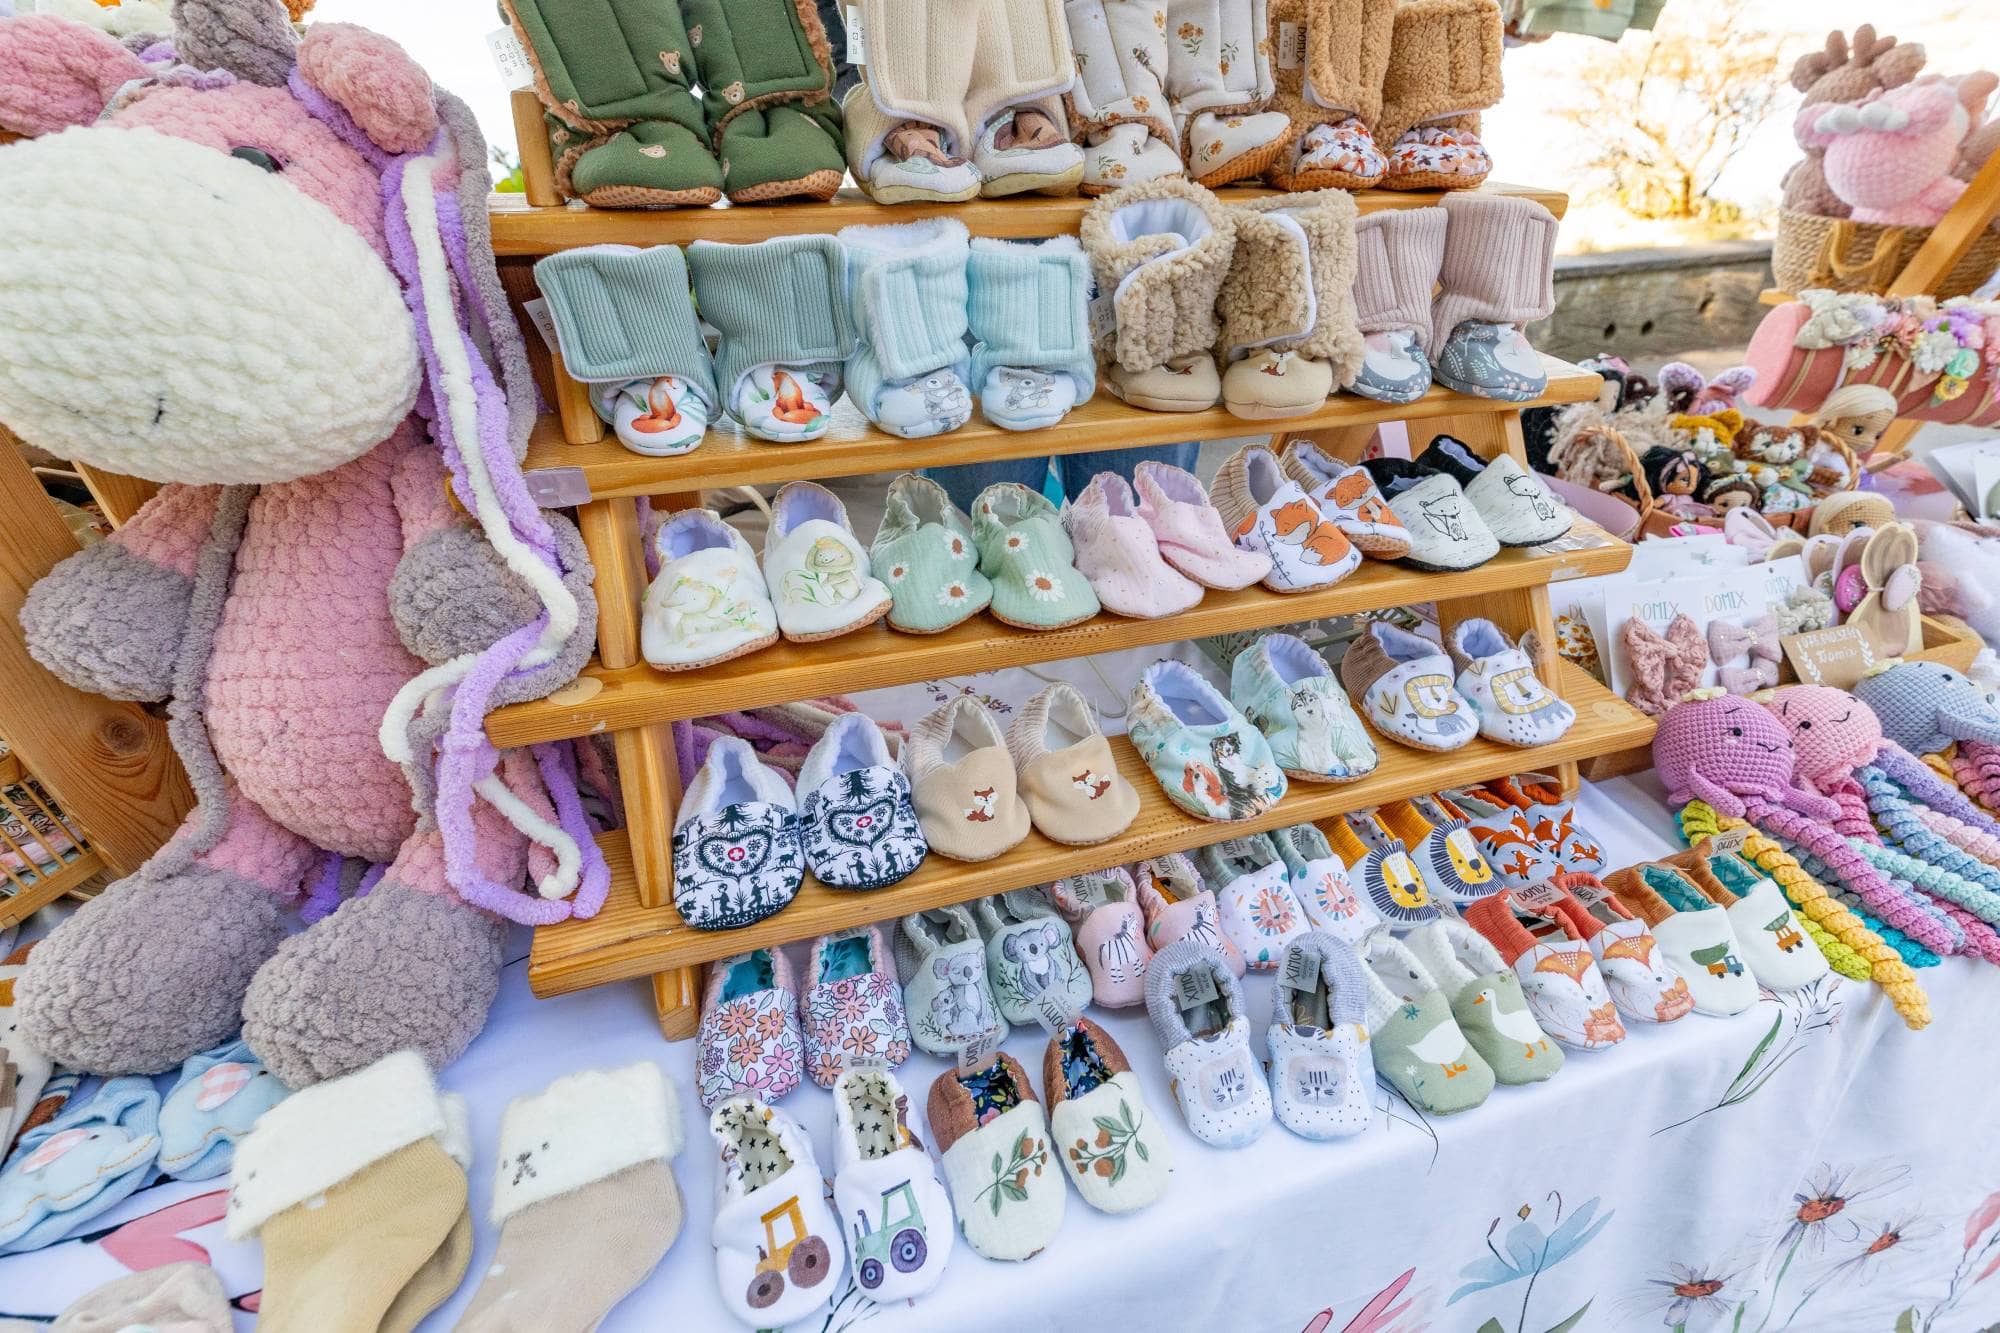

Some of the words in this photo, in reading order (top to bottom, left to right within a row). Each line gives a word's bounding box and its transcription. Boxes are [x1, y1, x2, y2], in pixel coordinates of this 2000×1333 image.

[1296, 26, 1307, 63] DOMIX
[1631, 601, 1680, 621] DOMIX
[1704, 591, 1750, 613] DOMIX
[1516, 884, 1552, 902] DOMIX
[1037, 995, 1066, 1034] DOMIX
